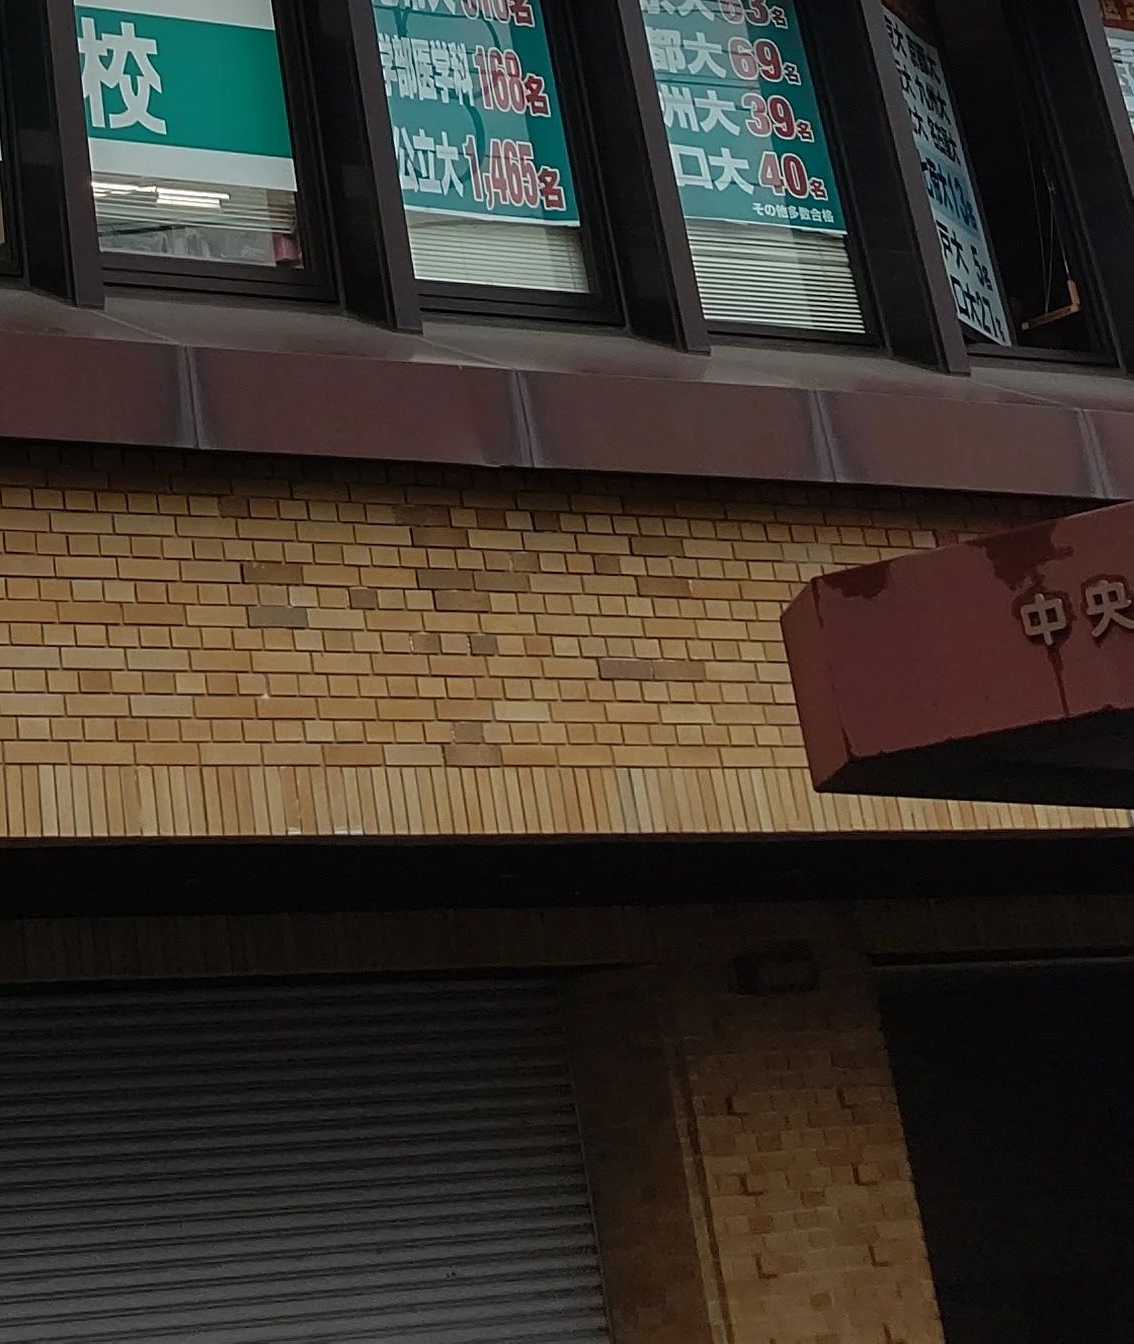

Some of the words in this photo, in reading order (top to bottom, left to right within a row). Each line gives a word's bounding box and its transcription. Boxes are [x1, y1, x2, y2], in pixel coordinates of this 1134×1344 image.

[752, 202, 835, 224] その他多数合格
[1020, 579, 1134, 646] 中央
